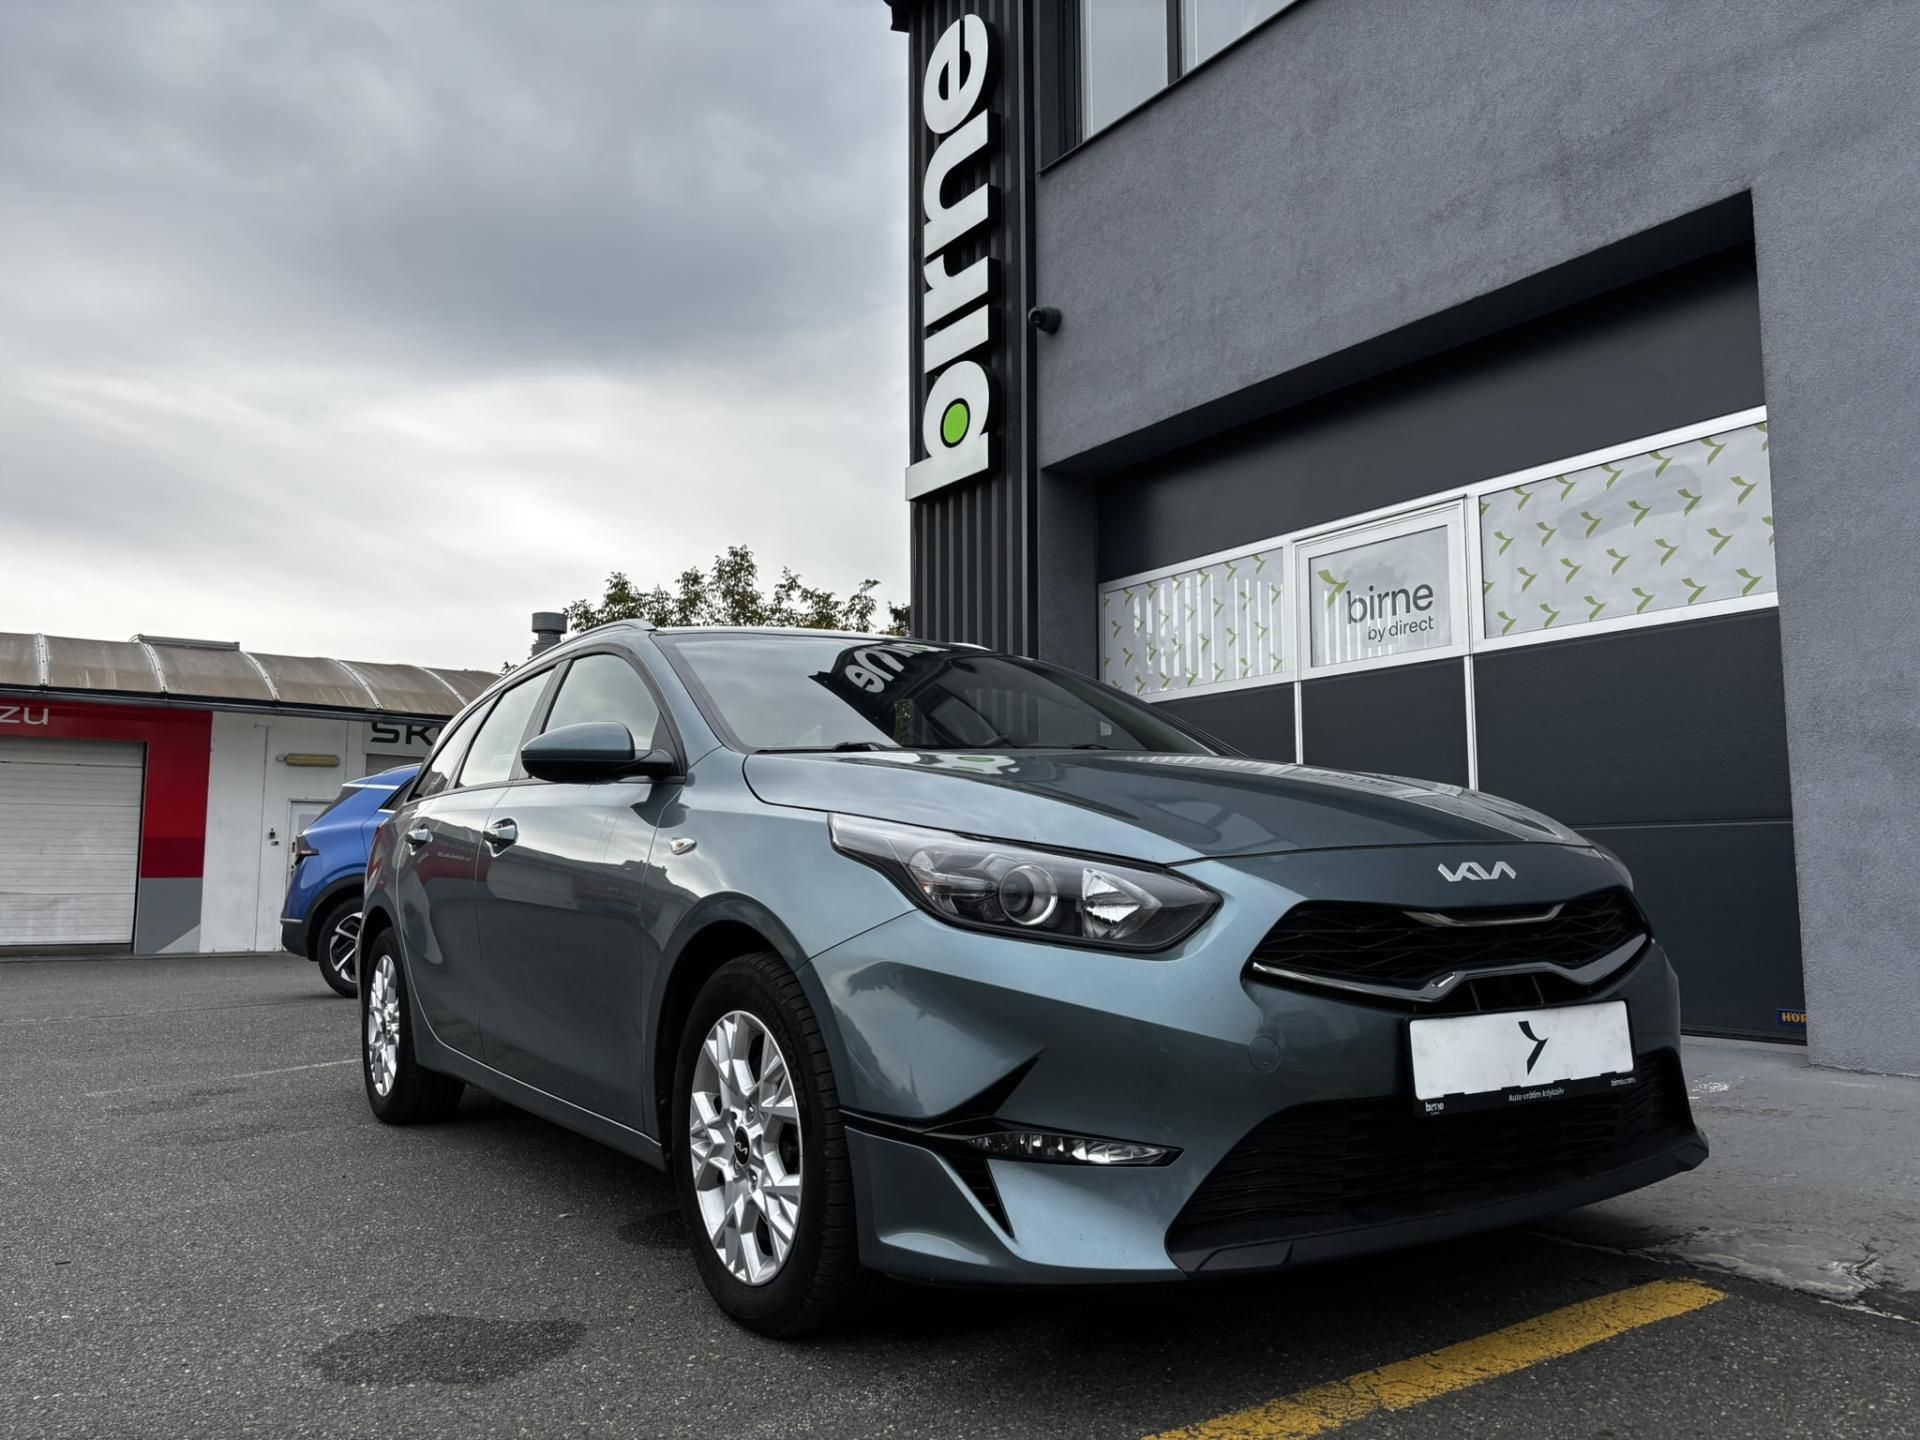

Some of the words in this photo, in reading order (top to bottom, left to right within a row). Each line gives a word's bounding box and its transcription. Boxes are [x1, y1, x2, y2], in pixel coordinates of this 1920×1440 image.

[905, 14, 989, 500] birne
[1346, 584, 1434, 625] birne
[1368, 626, 1386, 643] by
[1389, 616, 1434, 637] direct
[370, 721, 443, 746] SK
[1437, 861, 1517, 882] KIA
